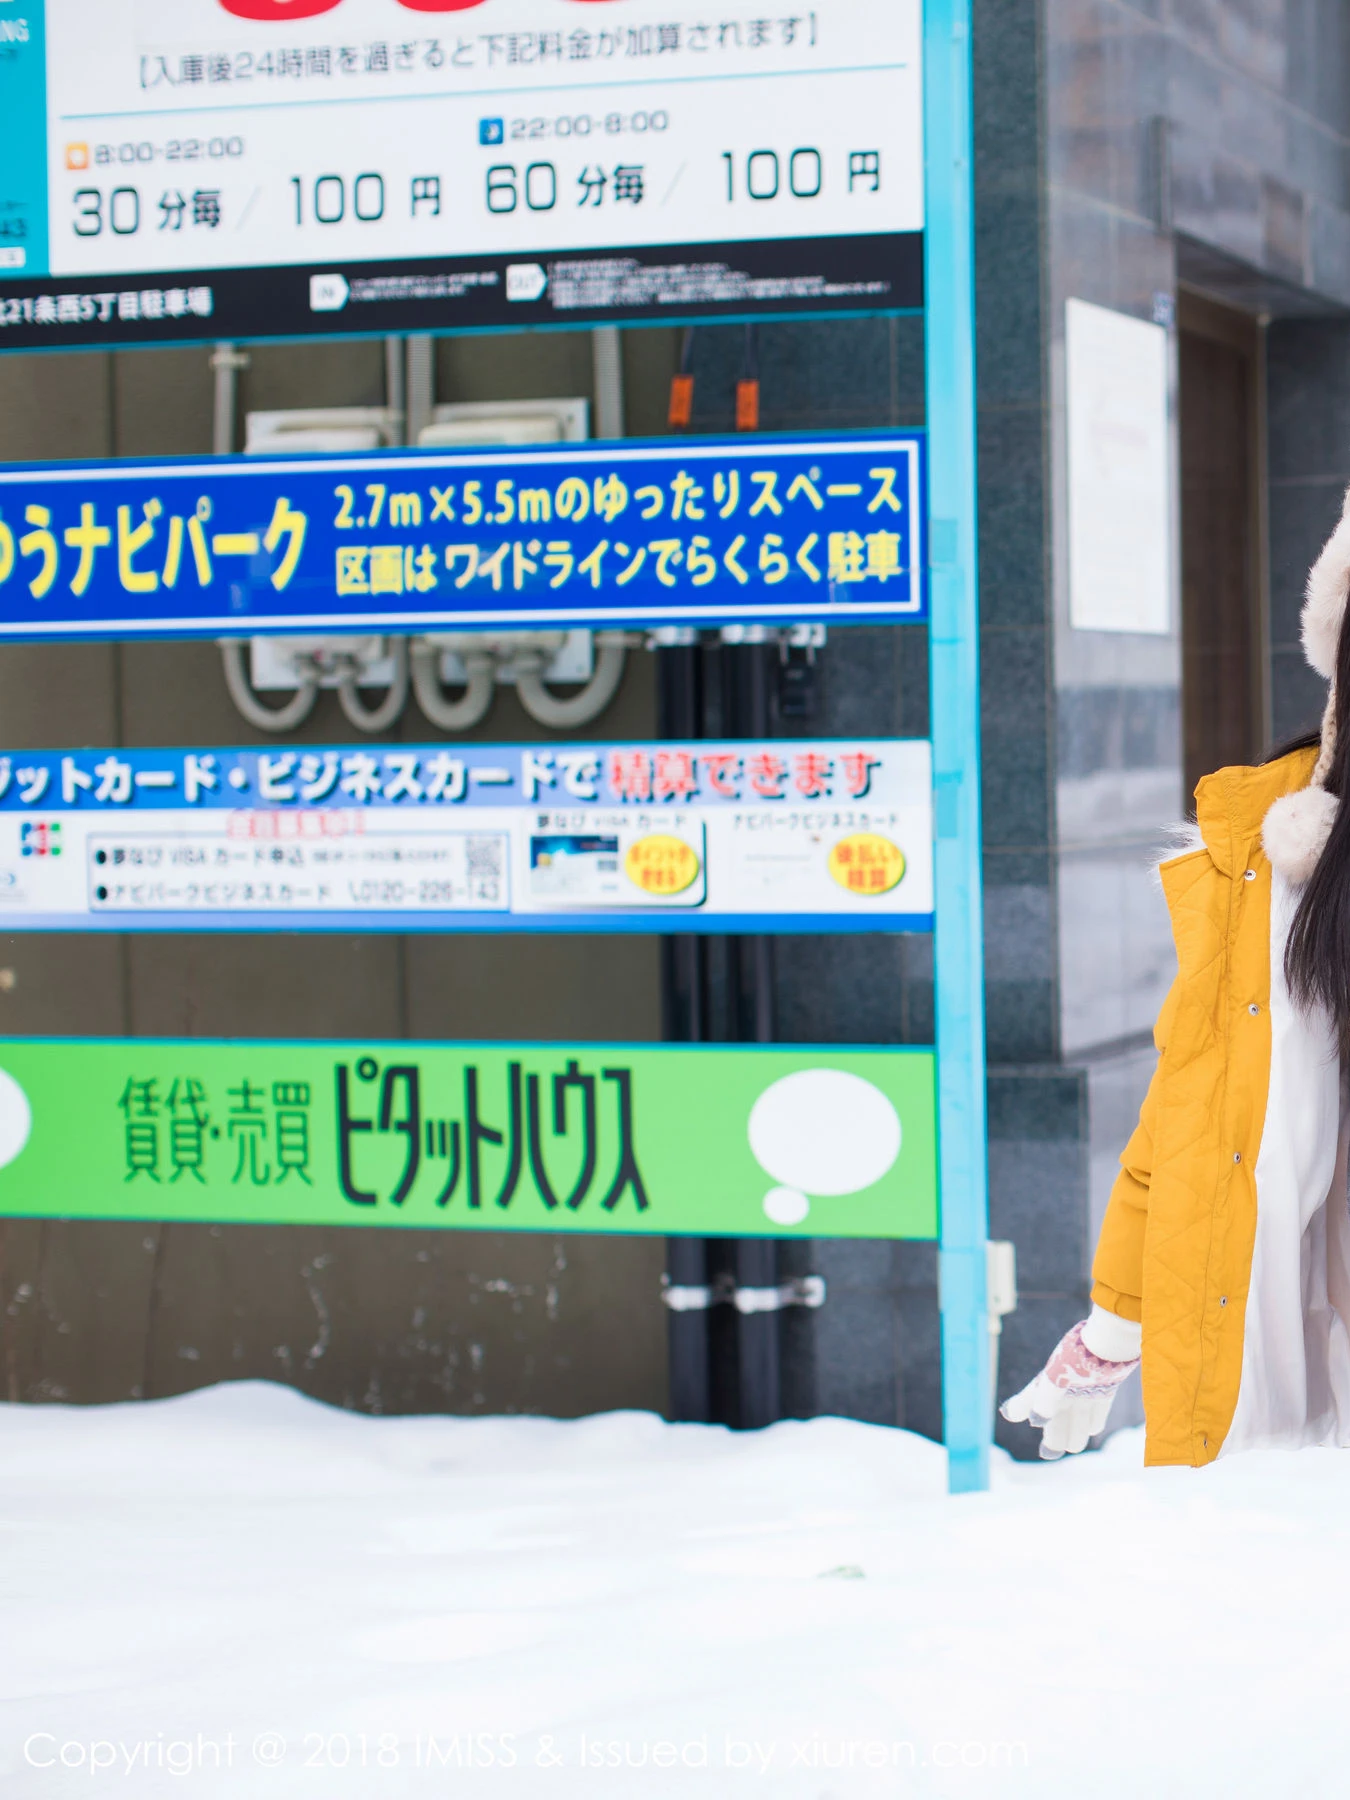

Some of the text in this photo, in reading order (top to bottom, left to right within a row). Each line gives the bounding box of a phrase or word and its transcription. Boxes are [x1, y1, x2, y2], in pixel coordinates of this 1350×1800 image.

[73, 173, 441, 236] 30 分毎 100 円
[486, 147, 881, 213] 60 分毎 100 円
[333, 1058, 650, 1213] ピタットハウス
